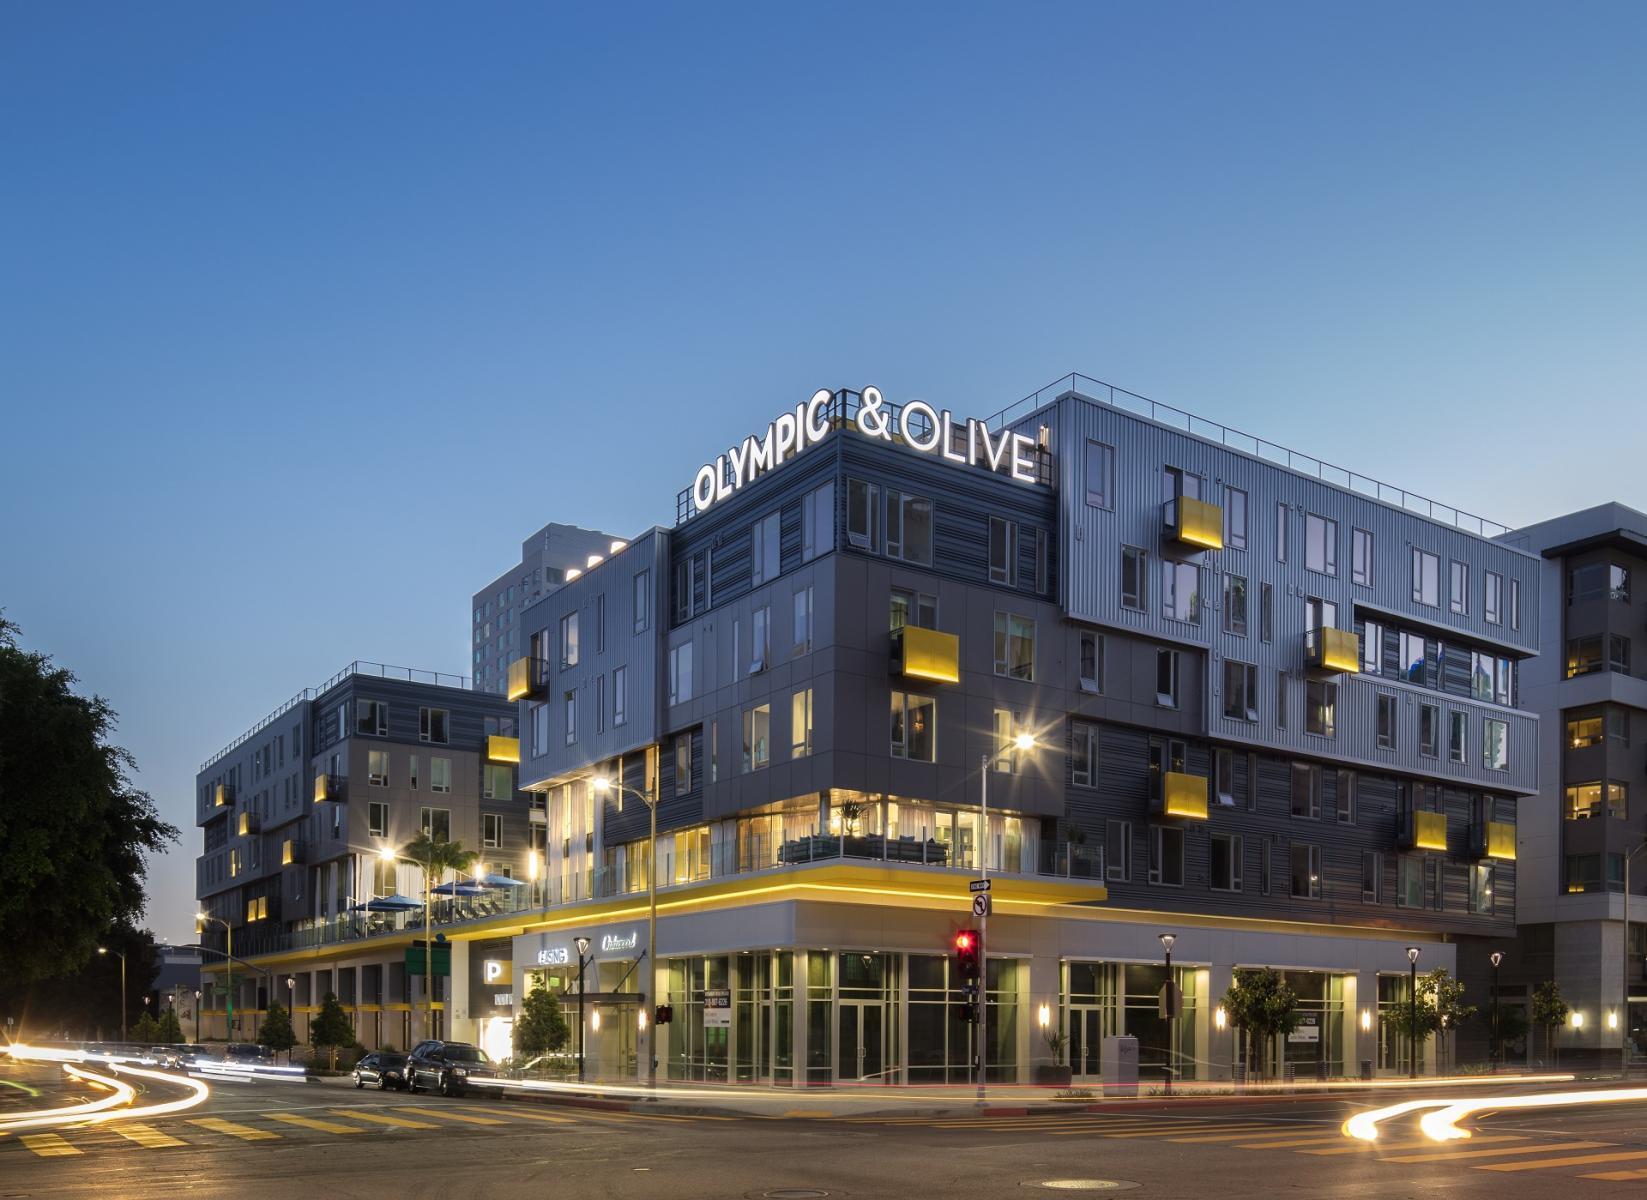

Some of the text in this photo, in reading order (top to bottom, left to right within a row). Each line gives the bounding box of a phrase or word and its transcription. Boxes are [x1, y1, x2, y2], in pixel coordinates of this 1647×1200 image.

[693, 385, 1036, 511] OLYMPIC & OLIVE
[487, 962, 501, 982] P
